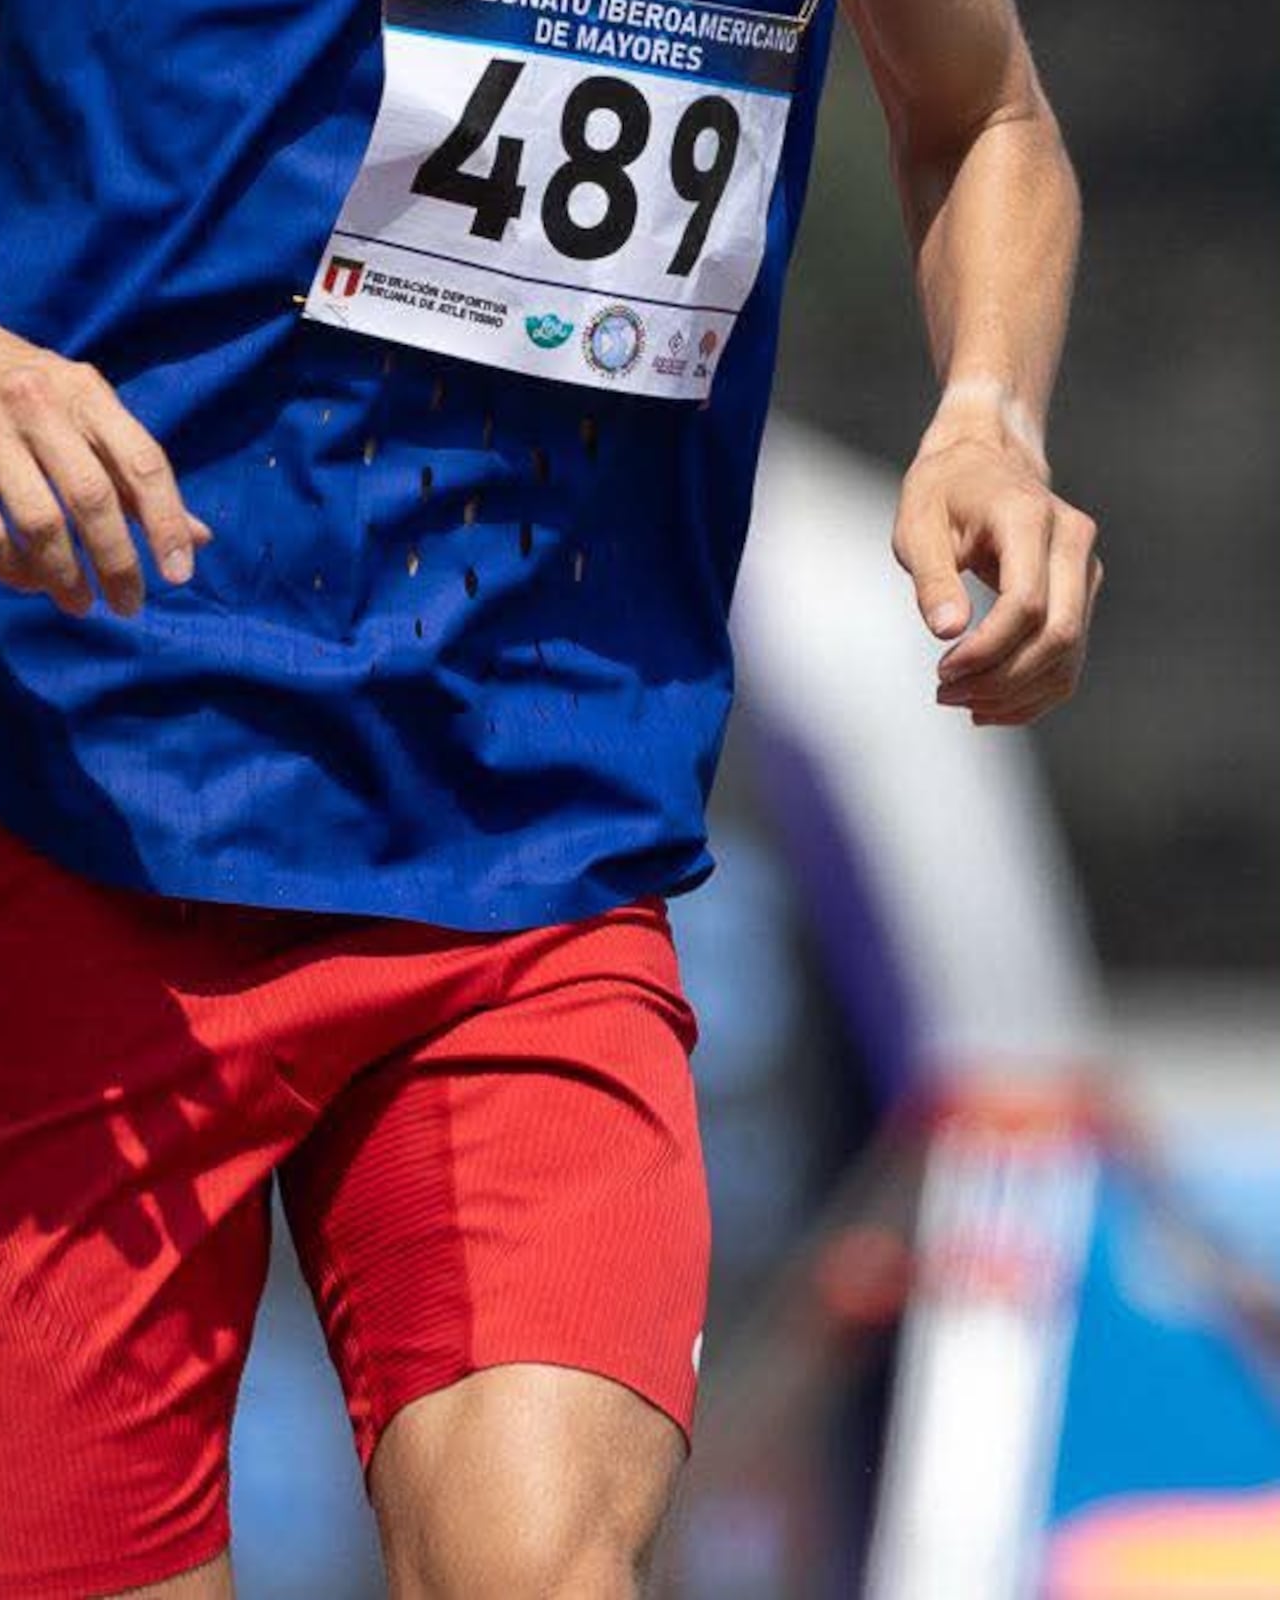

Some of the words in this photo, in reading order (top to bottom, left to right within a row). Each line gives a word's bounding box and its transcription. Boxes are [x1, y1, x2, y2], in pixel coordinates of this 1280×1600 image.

[534, 16, 571, 49] DE
[575, 23, 704, 72] MAYORES
[410, 57, 741, 278] 489
